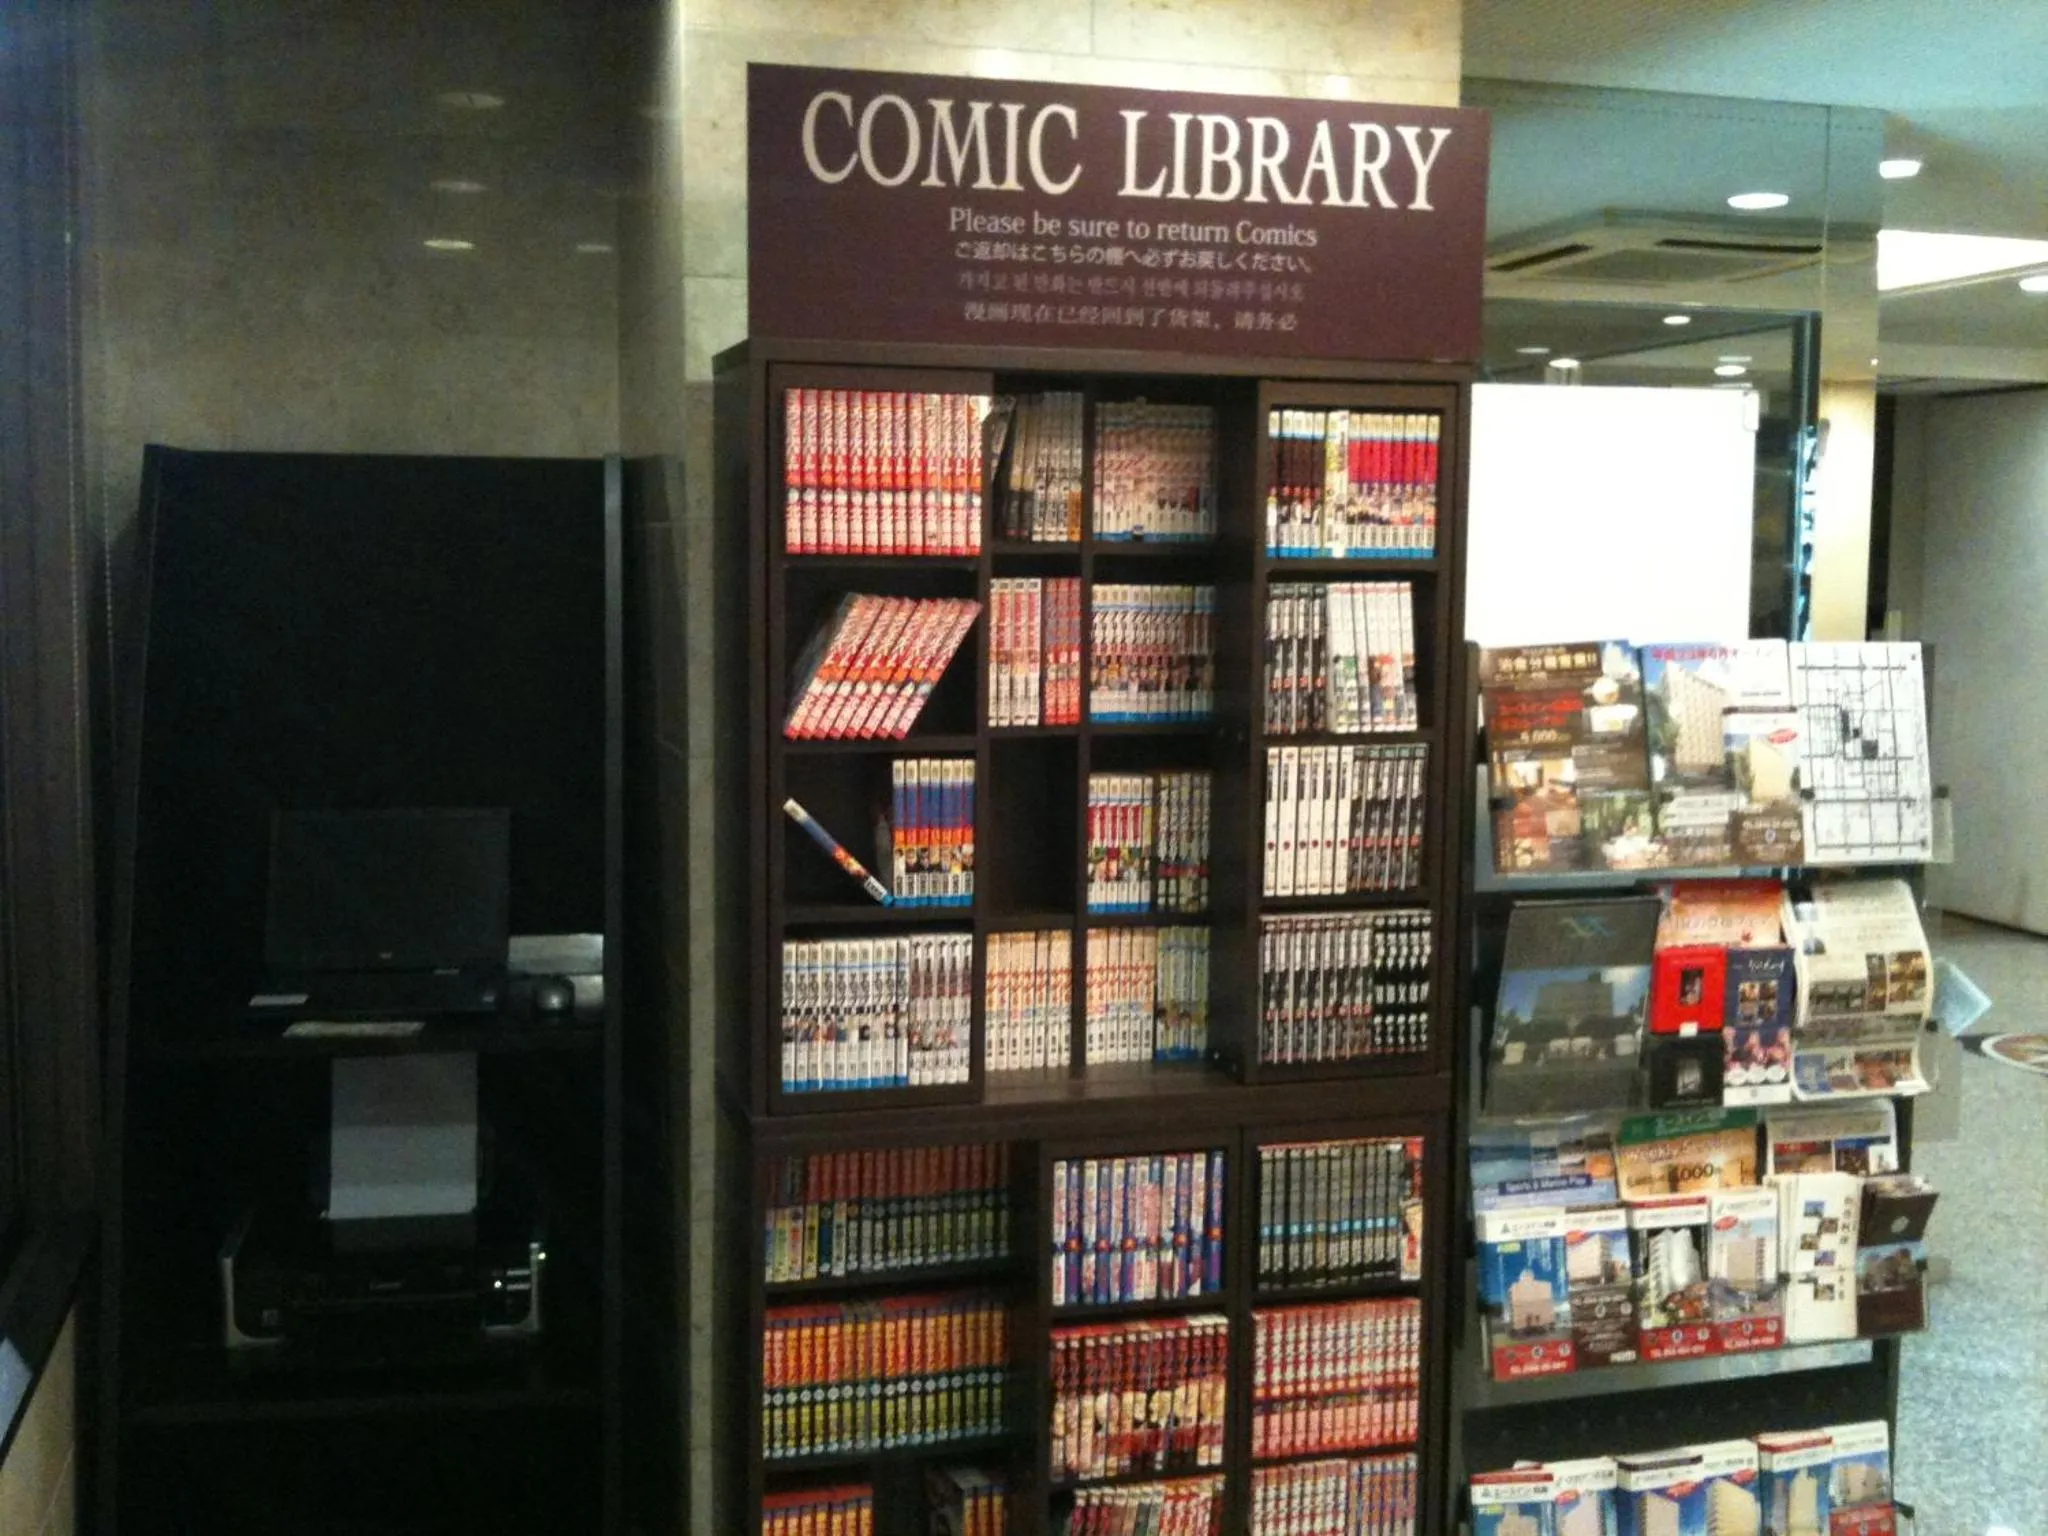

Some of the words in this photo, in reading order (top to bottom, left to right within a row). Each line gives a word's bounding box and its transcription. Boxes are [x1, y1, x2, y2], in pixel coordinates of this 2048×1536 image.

[802, 91, 1083, 195] COMIC
[1117, 109, 1453, 211] LIBRARY
[949, 206, 1026, 234] Please
[1032, 209, 1062, 236] be
[1067, 218, 1120, 239] sure
[1126, 219, 1150, 240] to
[1156, 222, 1230, 244] return
[1235, 219, 1318, 248] Comics
